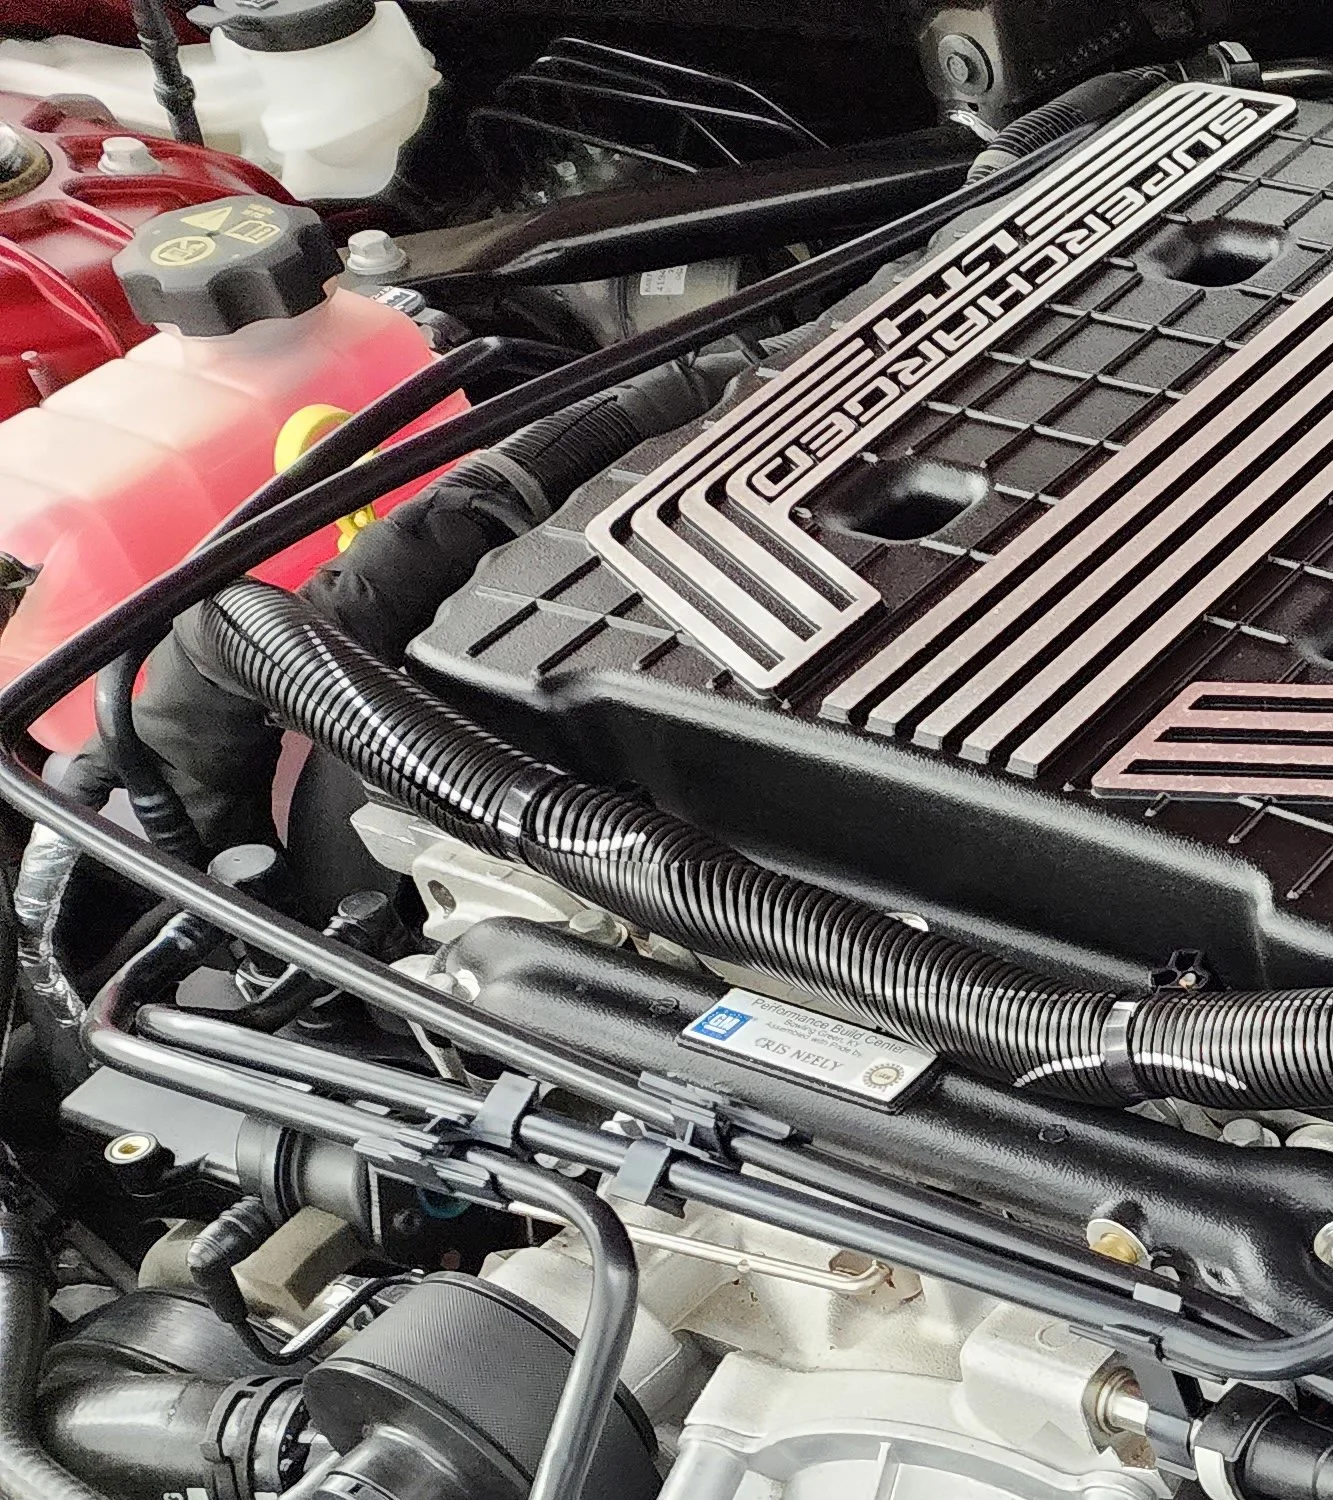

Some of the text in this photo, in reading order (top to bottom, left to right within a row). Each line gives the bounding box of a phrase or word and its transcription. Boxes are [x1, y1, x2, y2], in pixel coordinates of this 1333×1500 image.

[750, 100, 1257, 503] SUPERCHARGED
[873, 229, 1018, 345] LT4
[709, 1013, 740, 1030] GM
[752, 998, 907, 1056] Performance Build Center
[754, 1037, 844, 1074] CRIS NEELY
